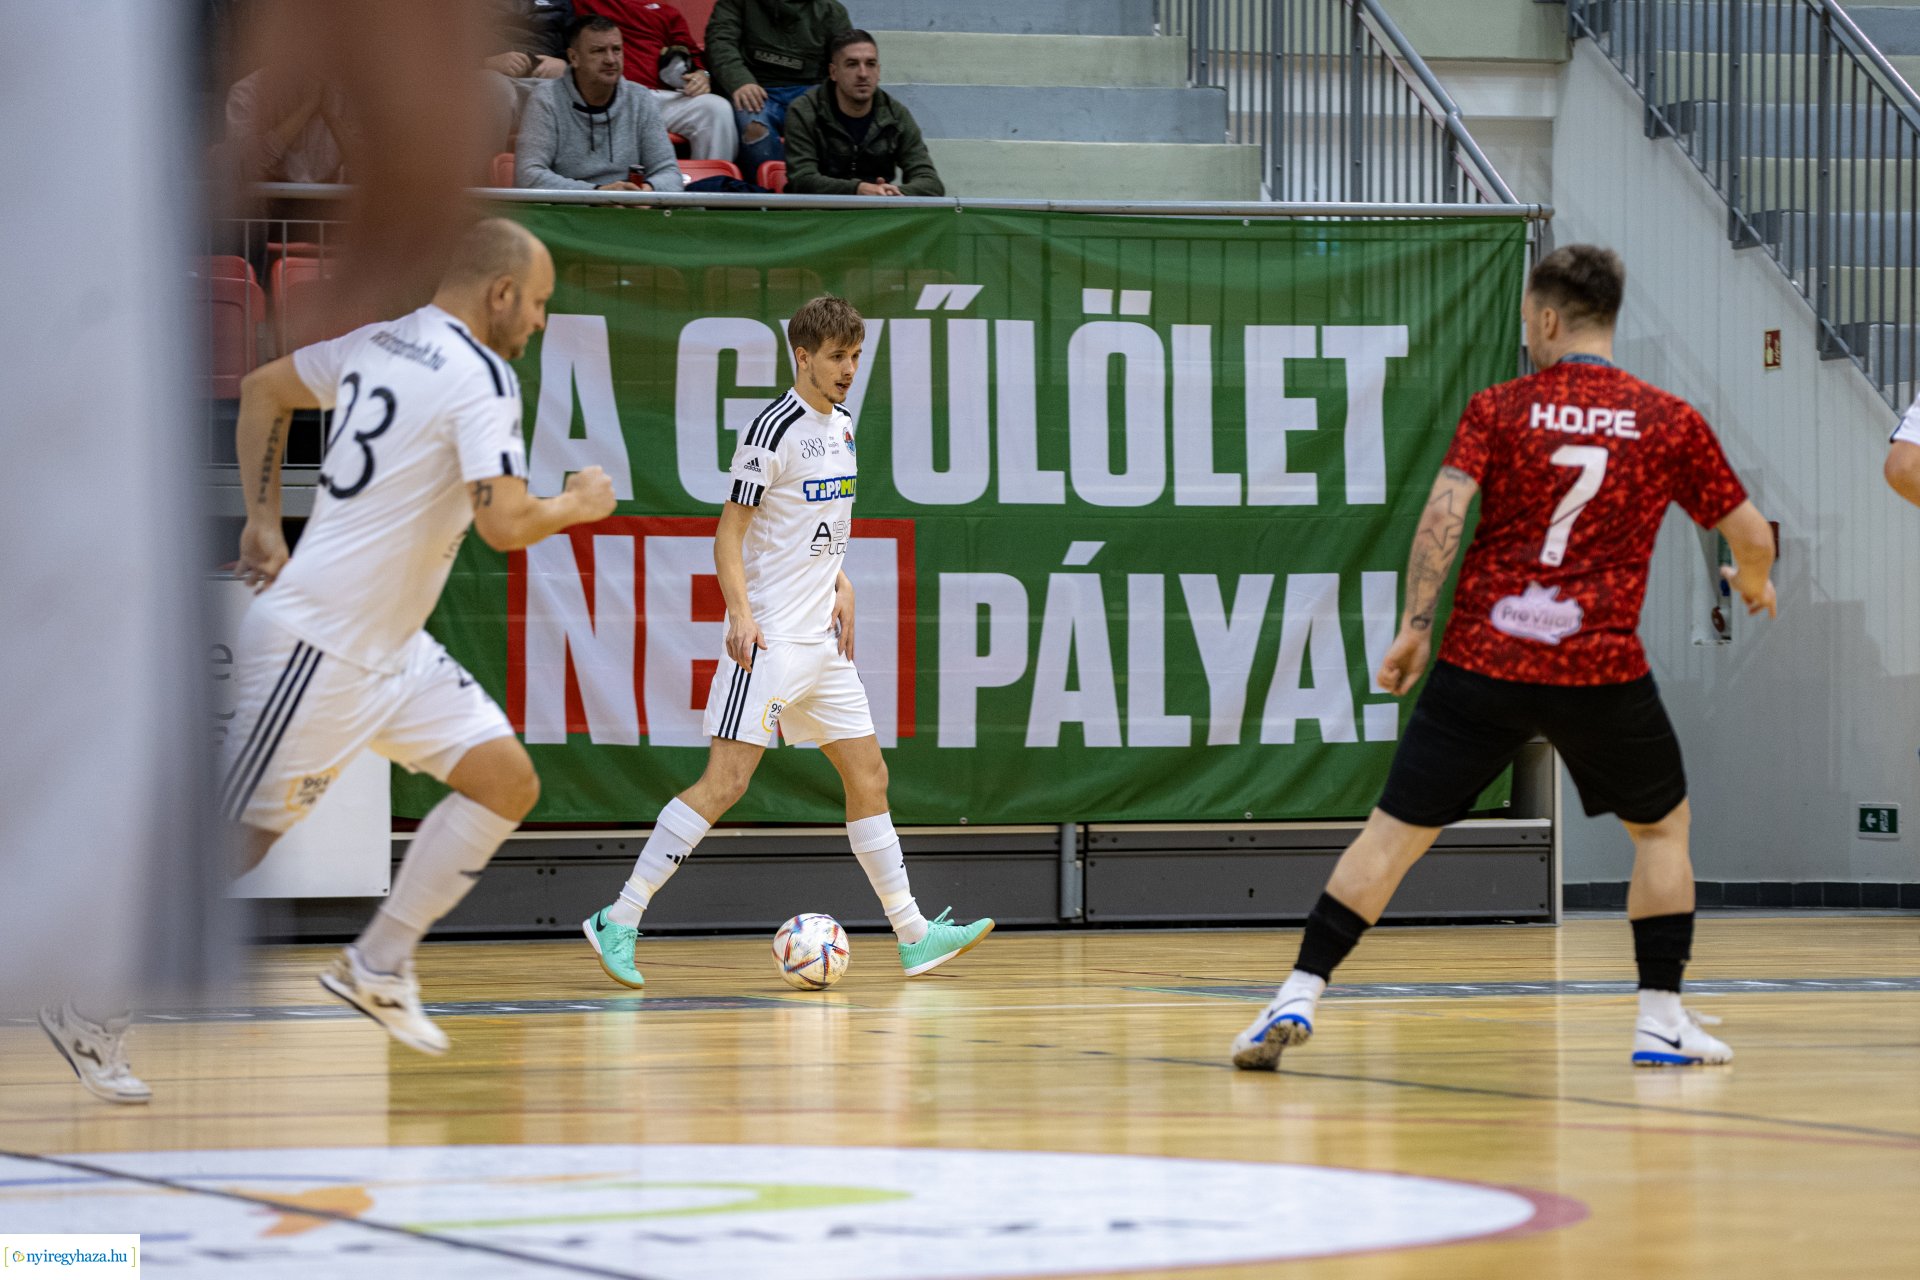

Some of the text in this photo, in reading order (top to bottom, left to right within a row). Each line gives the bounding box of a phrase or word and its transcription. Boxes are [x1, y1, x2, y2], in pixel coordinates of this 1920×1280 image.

[528, 313, 634, 500] A
[800, 437, 825, 459] 383
[1530, 403, 1641, 439] H.O.P.E.
[1540, 445, 1609, 567] 7
[937, 541, 1399, 748] PÁLYA!
